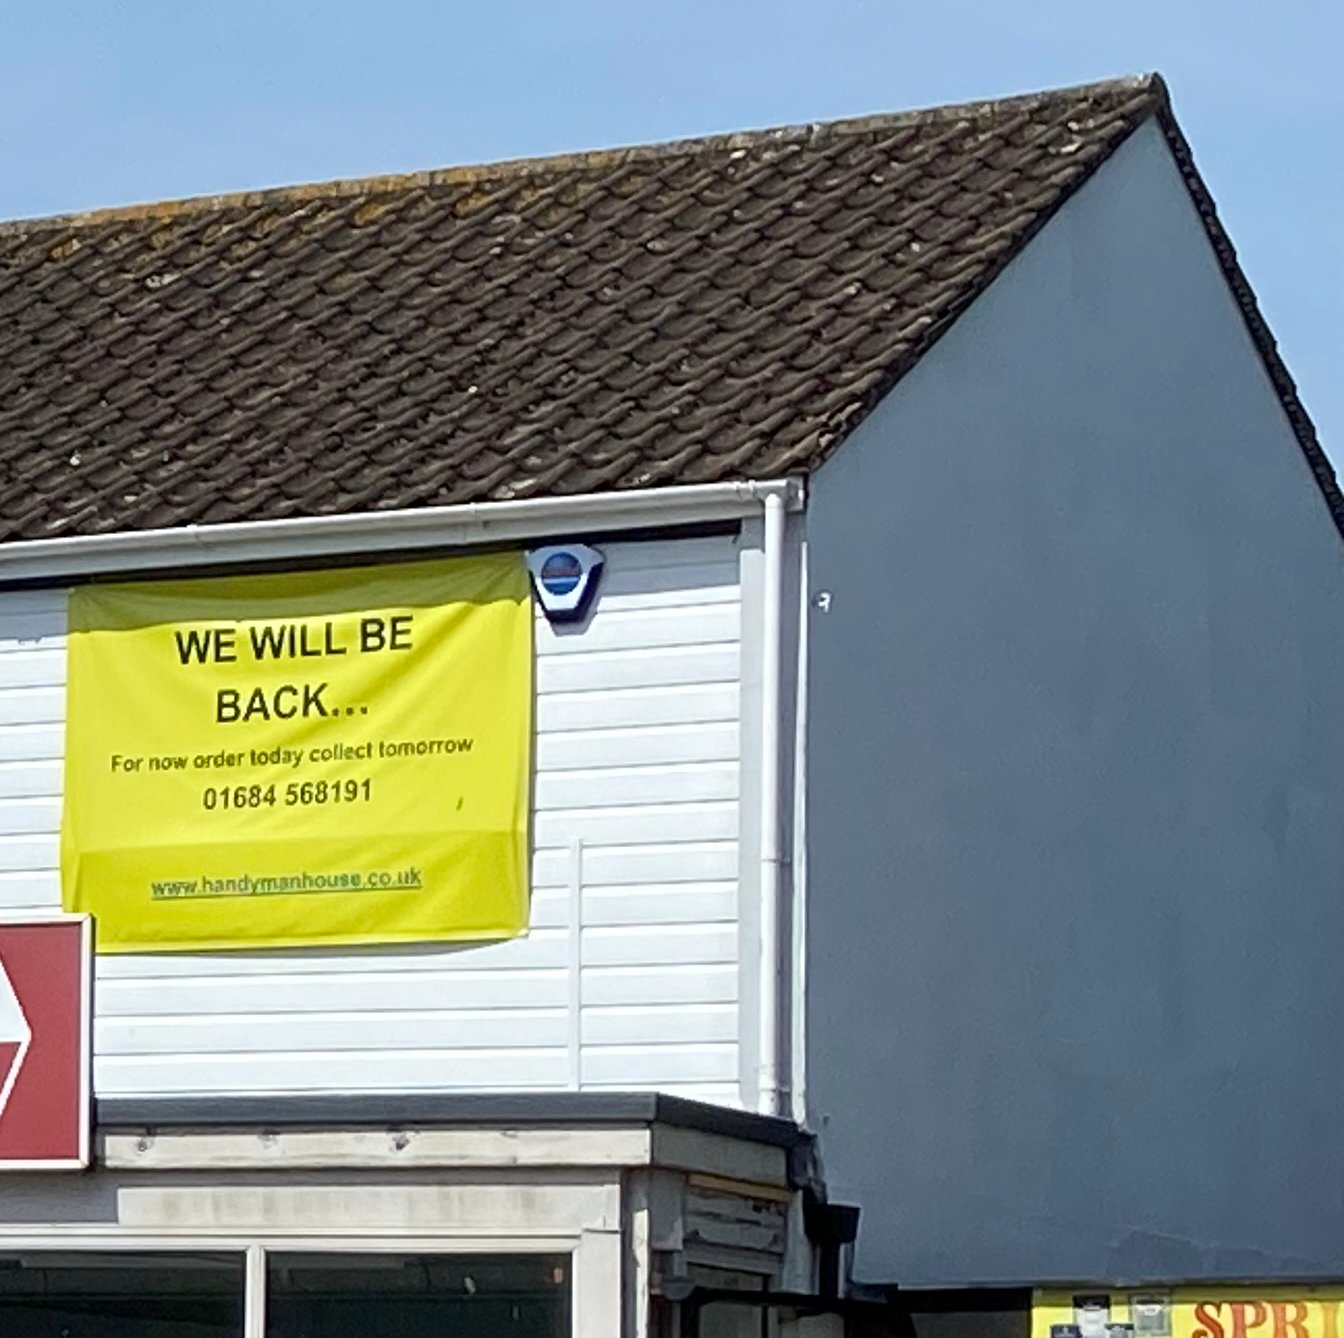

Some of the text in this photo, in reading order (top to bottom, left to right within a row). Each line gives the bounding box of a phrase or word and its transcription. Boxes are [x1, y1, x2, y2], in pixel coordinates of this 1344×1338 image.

[175, 615, 414, 665] WE WILL BE
[216, 683, 369, 724] BACK...
[111, 737, 474, 772] For now order today collect tomorrow
[203, 778, 372, 810] 01684 568191
[151, 867, 422, 898] www.handymanhouse.co.uk
